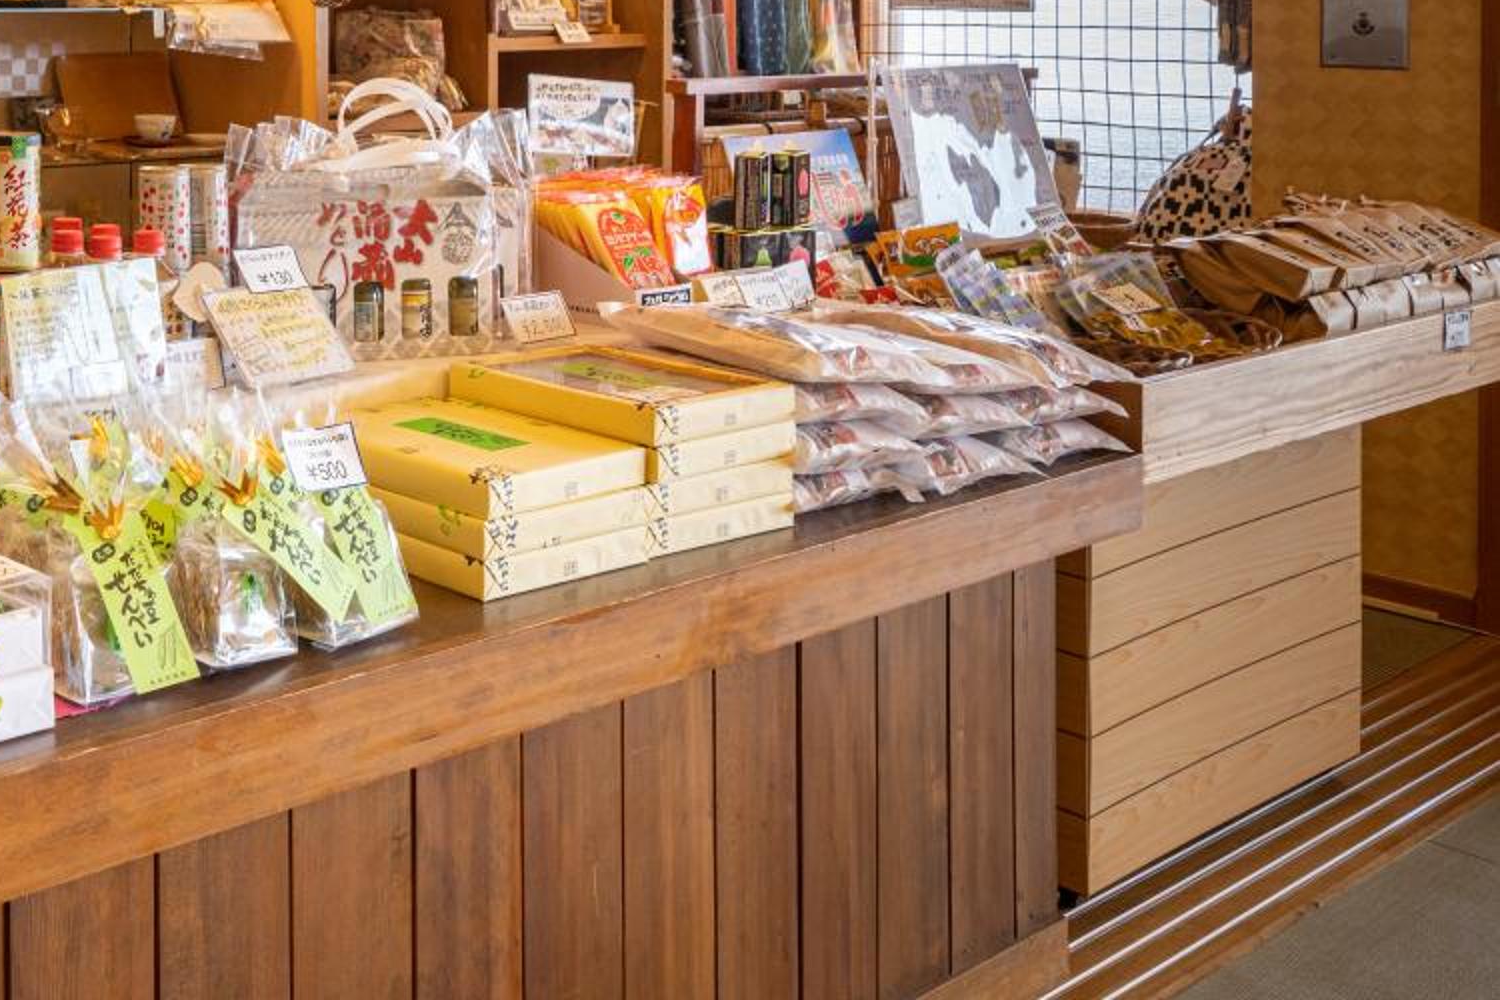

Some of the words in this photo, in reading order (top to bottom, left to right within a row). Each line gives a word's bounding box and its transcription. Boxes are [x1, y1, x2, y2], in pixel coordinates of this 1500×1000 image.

[307, 459, 348, 482] ¥500
[104, 571, 153, 648] せんべい
